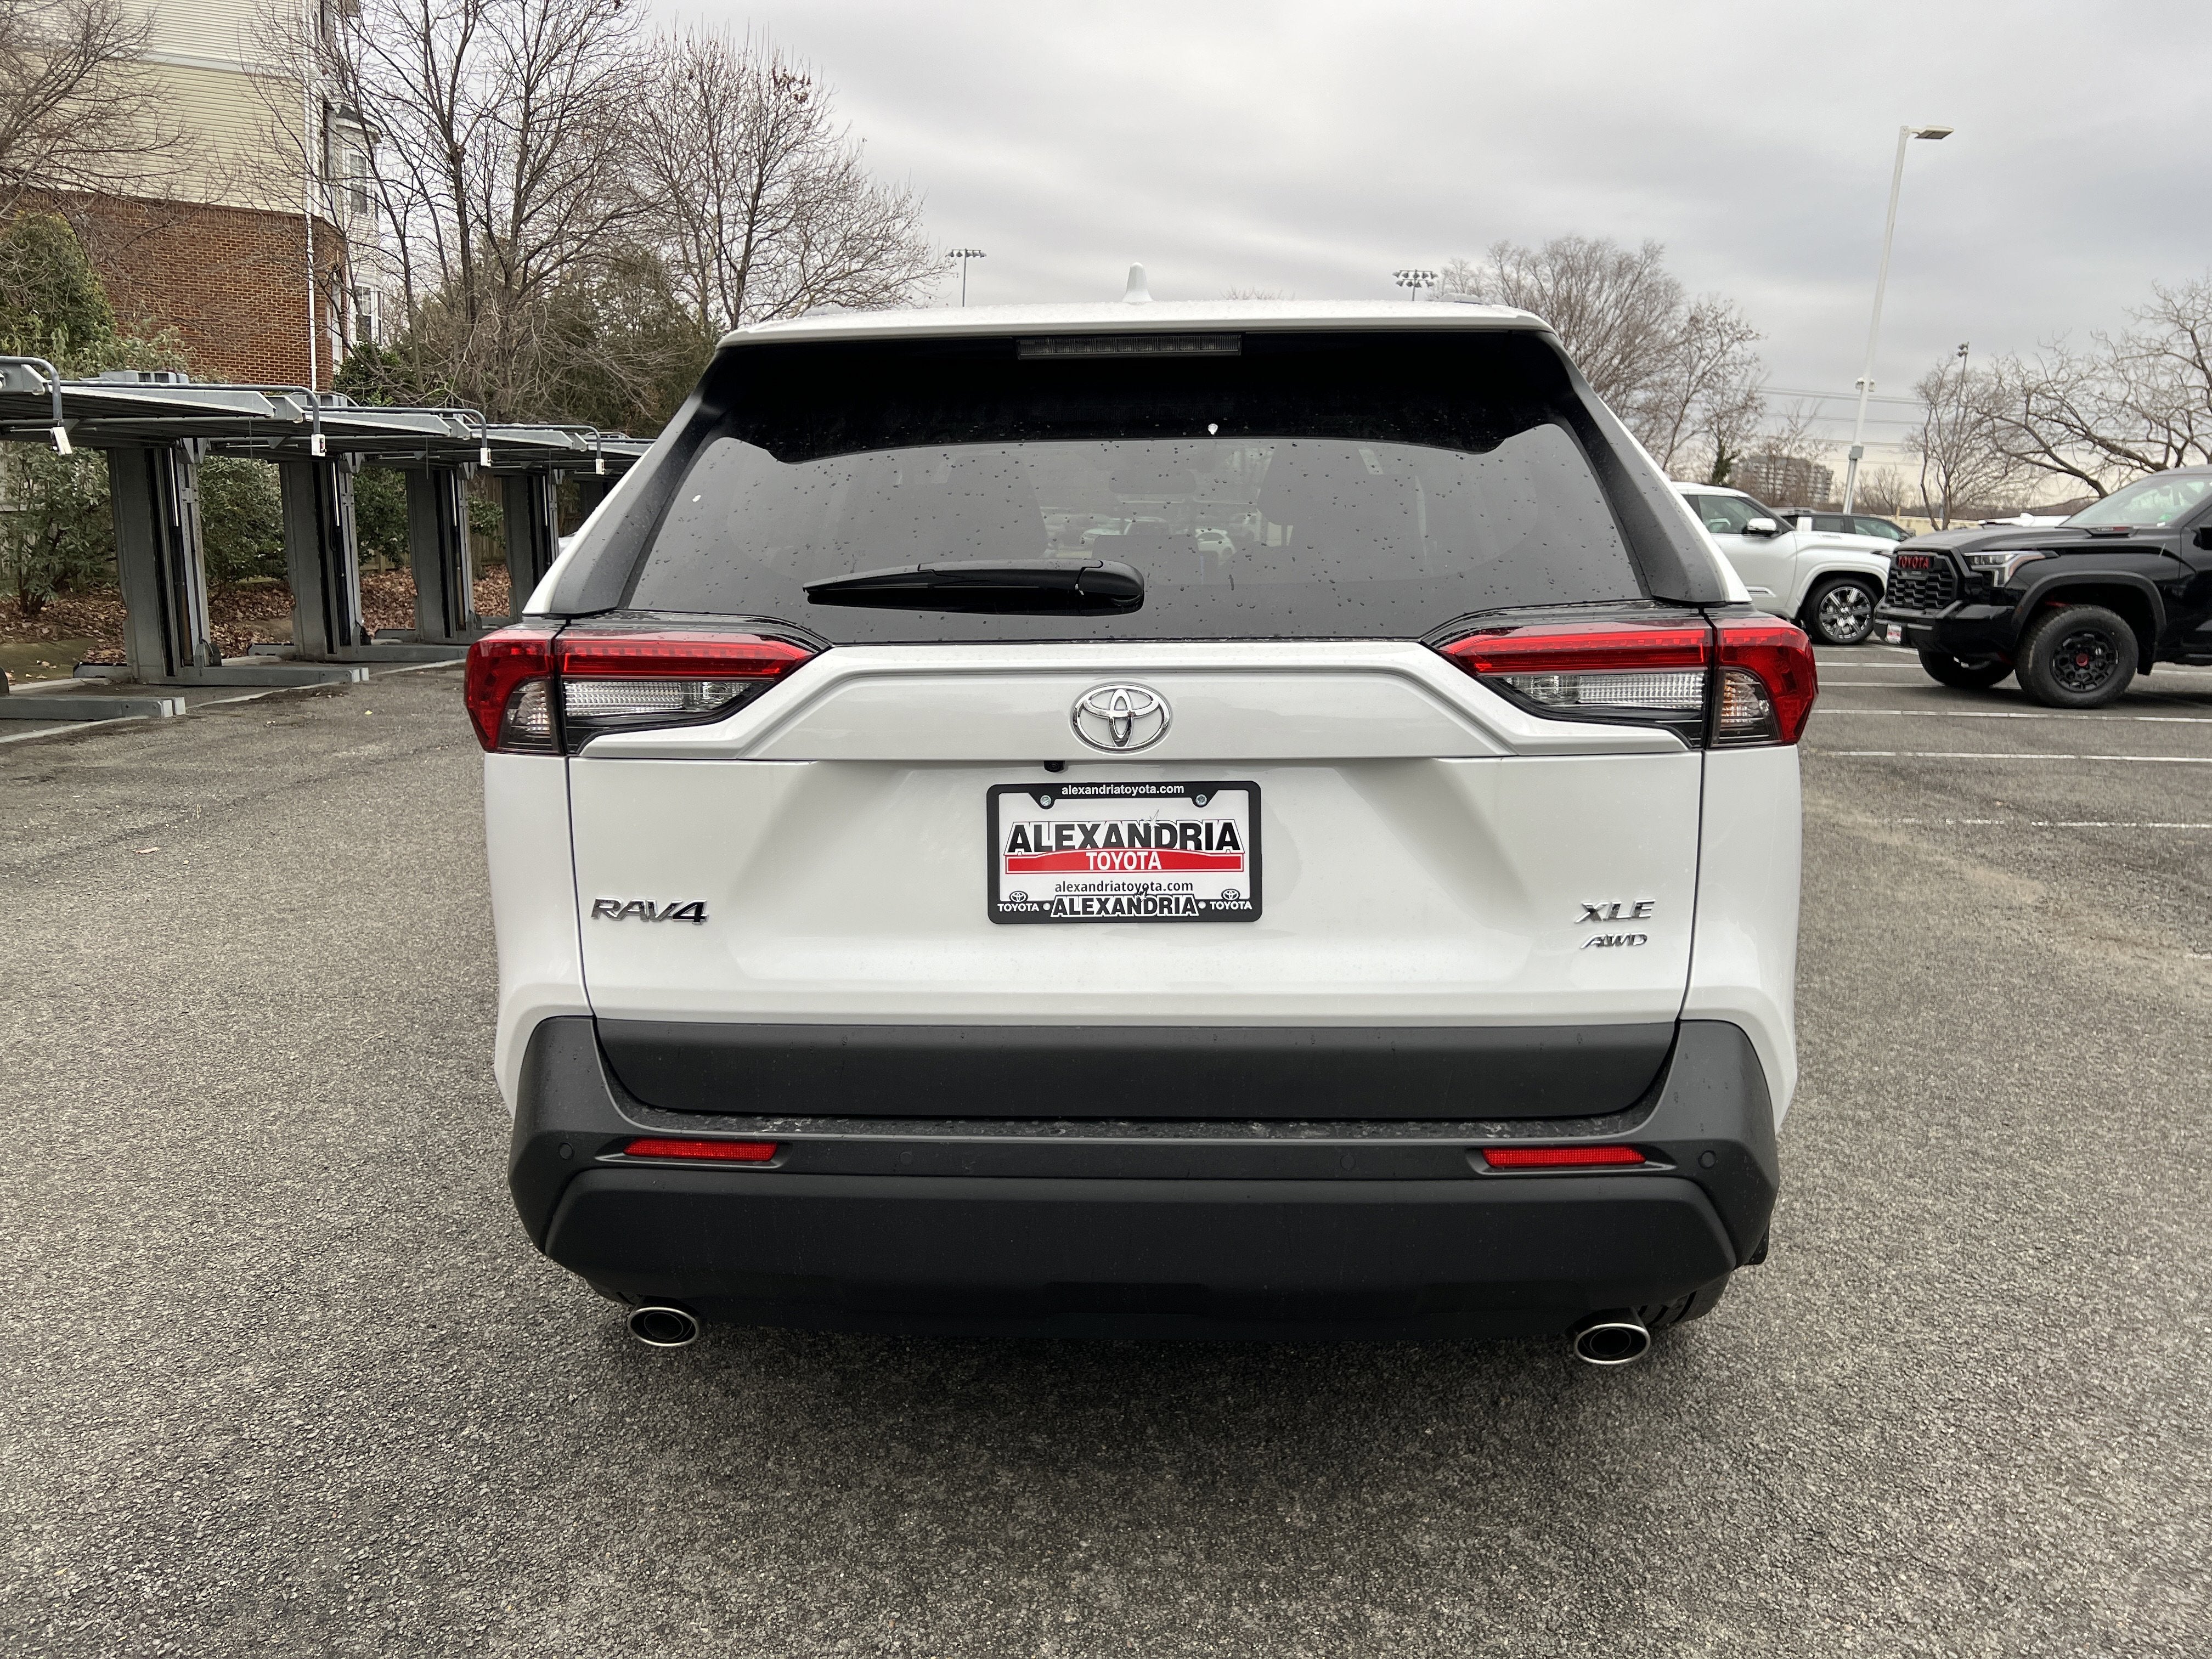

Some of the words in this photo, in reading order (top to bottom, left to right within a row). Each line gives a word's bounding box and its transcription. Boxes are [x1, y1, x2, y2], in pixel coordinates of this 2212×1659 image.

[1898, 555, 1929, 569] TOYOTA
[1062, 784, 1184, 796] alexandriatoyota.com
[1007, 822, 1241, 853] ALEXANDRIA
[1086, 851, 1162, 870] TOYOTA
[1055, 880, 1193, 893] alexandriatoyota.com
[591, 897, 708, 925] RAV4
[997, 903, 1039, 912] TOYOTA
[1051, 895, 1199, 917] ALEXANDRIA
[1210, 901, 1252, 910] TOYOTA
[1574, 899, 1656, 923] XLE
[1579, 932, 1647, 949] AWD
